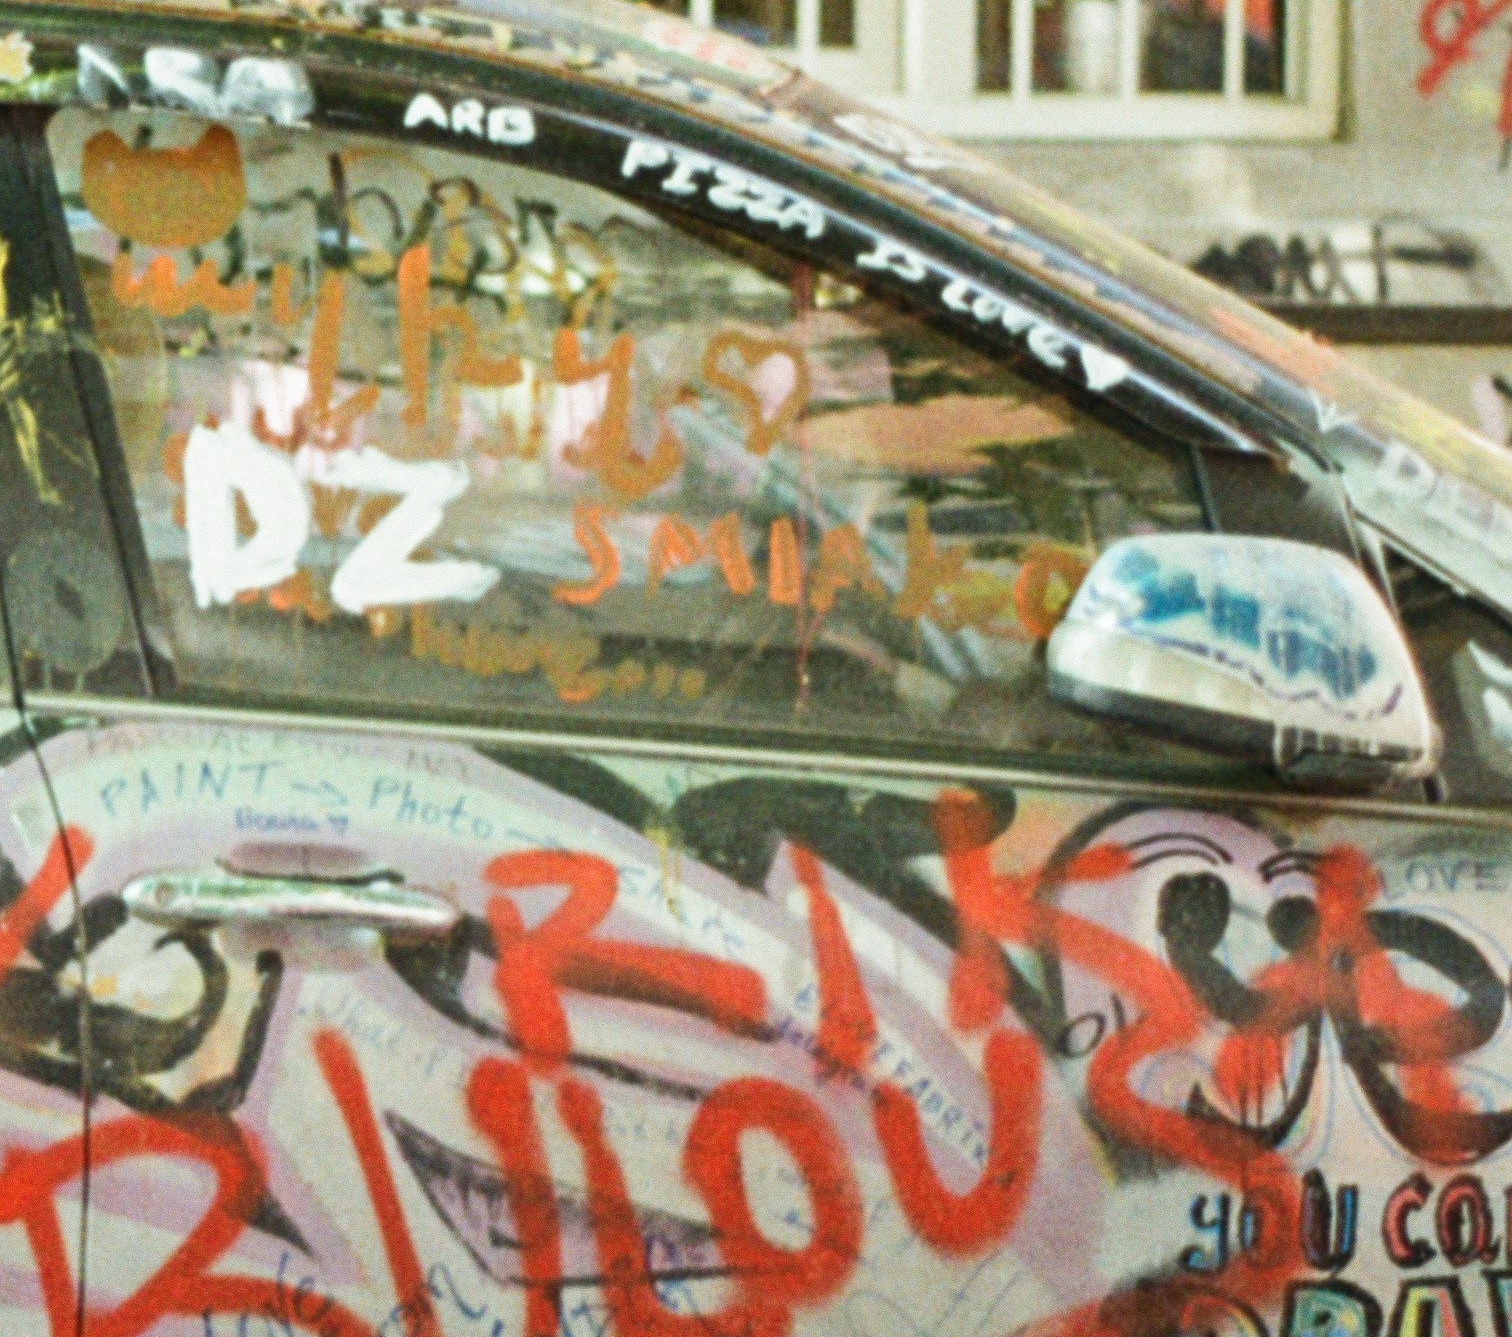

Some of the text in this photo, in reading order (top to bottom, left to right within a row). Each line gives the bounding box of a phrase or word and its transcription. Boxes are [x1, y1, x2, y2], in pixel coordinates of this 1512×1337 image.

[619, 137, 828, 242] PIZZA
[182, 419, 502, 615] DZ
[100, 759, 286, 819] PAINT
[369, 777, 497, 844] Photo
[1178, 1168, 1361, 1273] you
